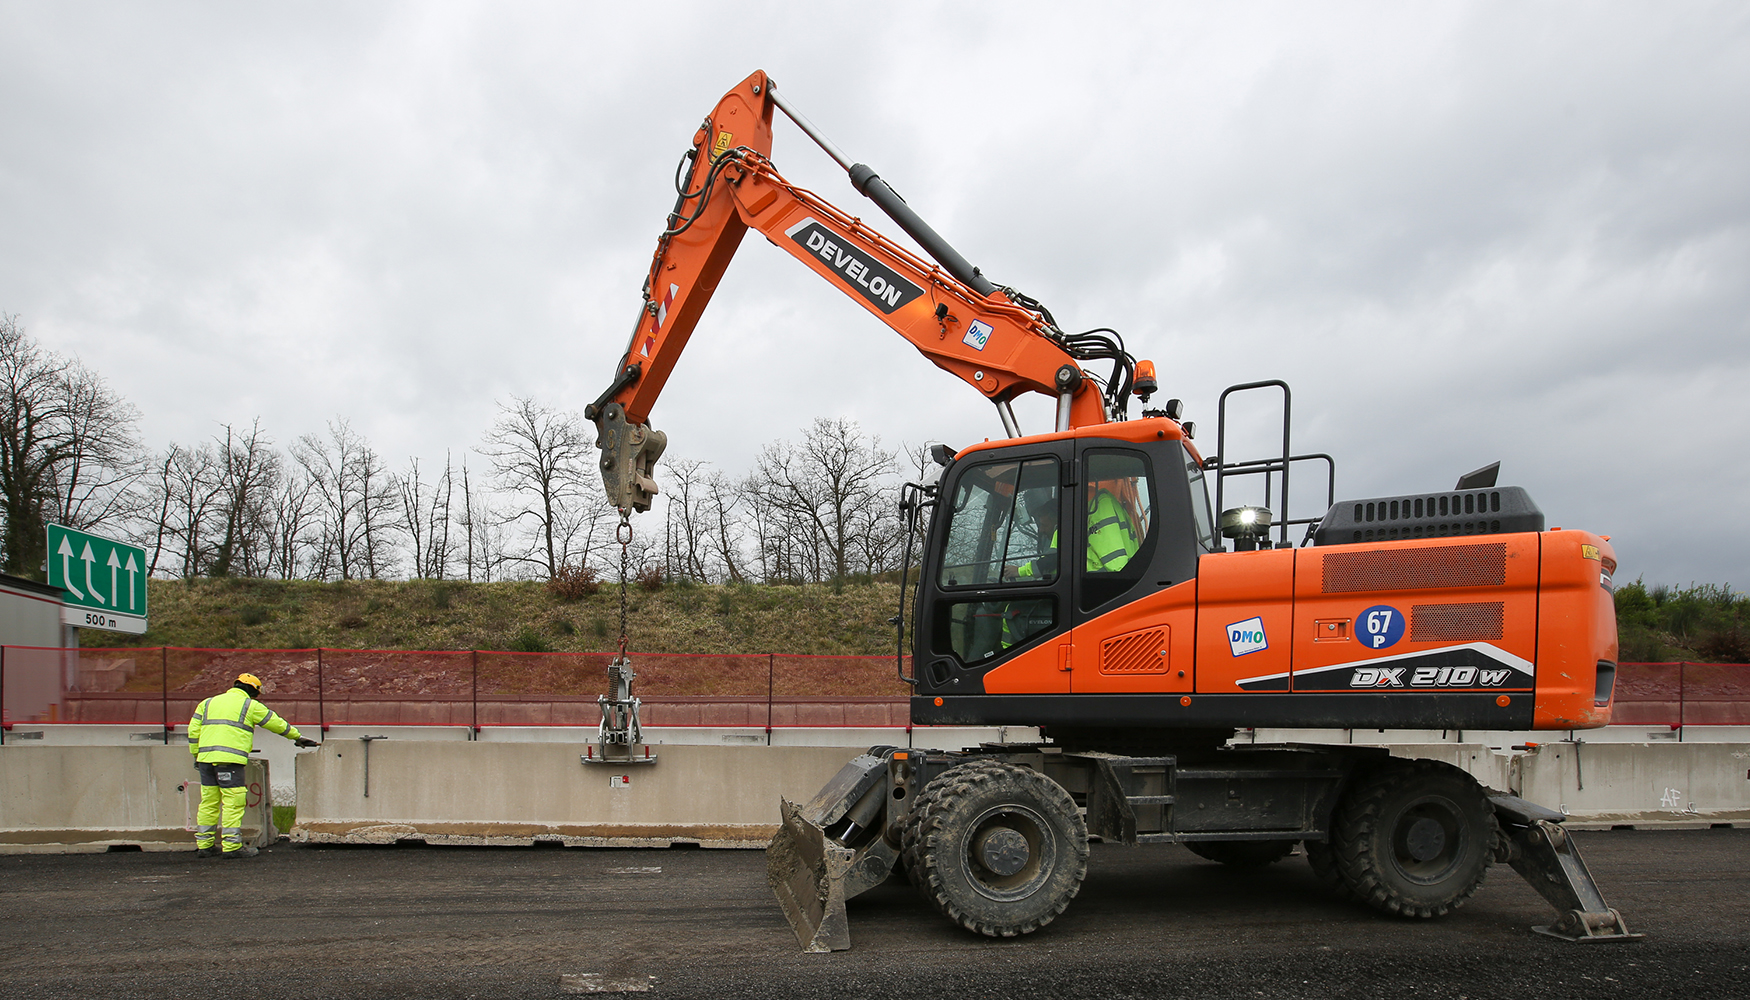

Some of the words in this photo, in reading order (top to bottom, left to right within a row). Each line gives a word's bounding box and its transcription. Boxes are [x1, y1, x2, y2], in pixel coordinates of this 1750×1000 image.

[806, 230, 902, 307] DEVELON
[969, 325, 987, 345] DMO
[85, 613, 106, 626] 500
[109, 619, 117, 628] m
[1367, 610, 1393, 634] 67
[1232, 630, 1264, 643] DMO
[1373, 635, 1386, 648] P
[1350, 667, 1406, 687] DX
[1660, 787, 1681, 807] AF
